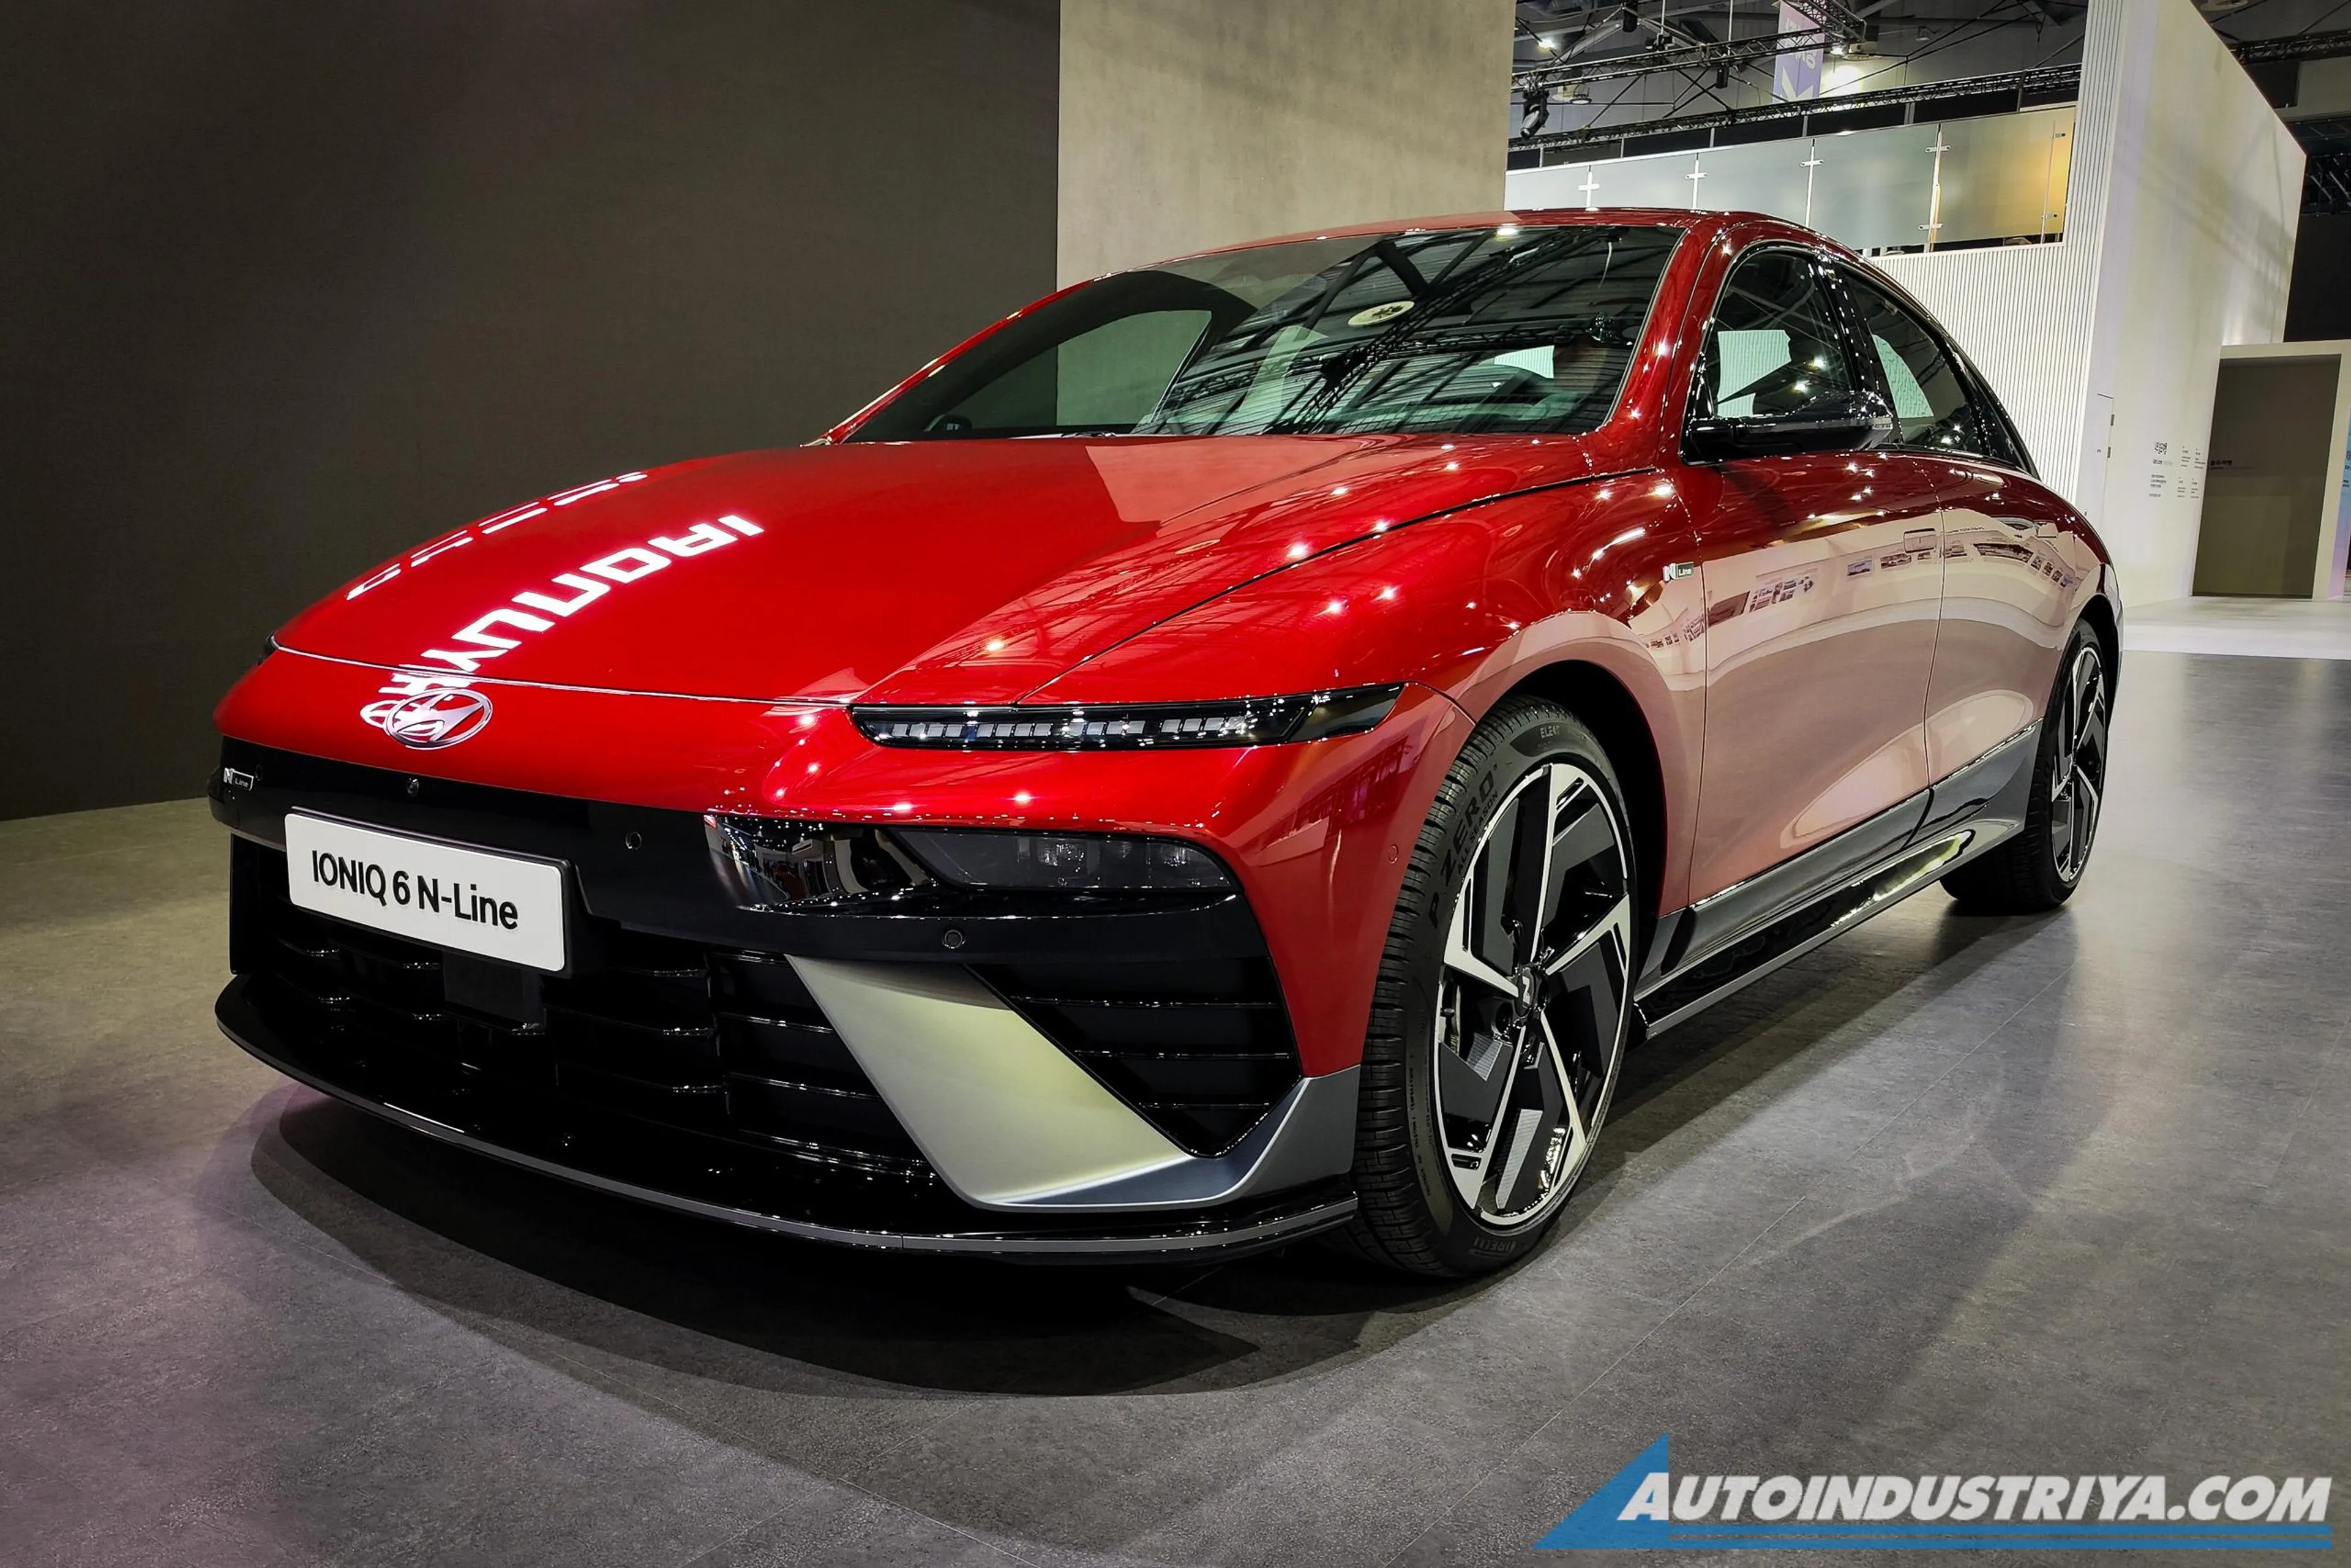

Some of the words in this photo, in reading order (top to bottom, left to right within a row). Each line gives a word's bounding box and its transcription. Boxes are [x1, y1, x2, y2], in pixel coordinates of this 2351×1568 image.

[312, 850, 387, 906] IONIQ
[393, 870, 411, 906] 6
[418, 875, 519, 929] N-Line
[1429, 891, 1439, 929] P
